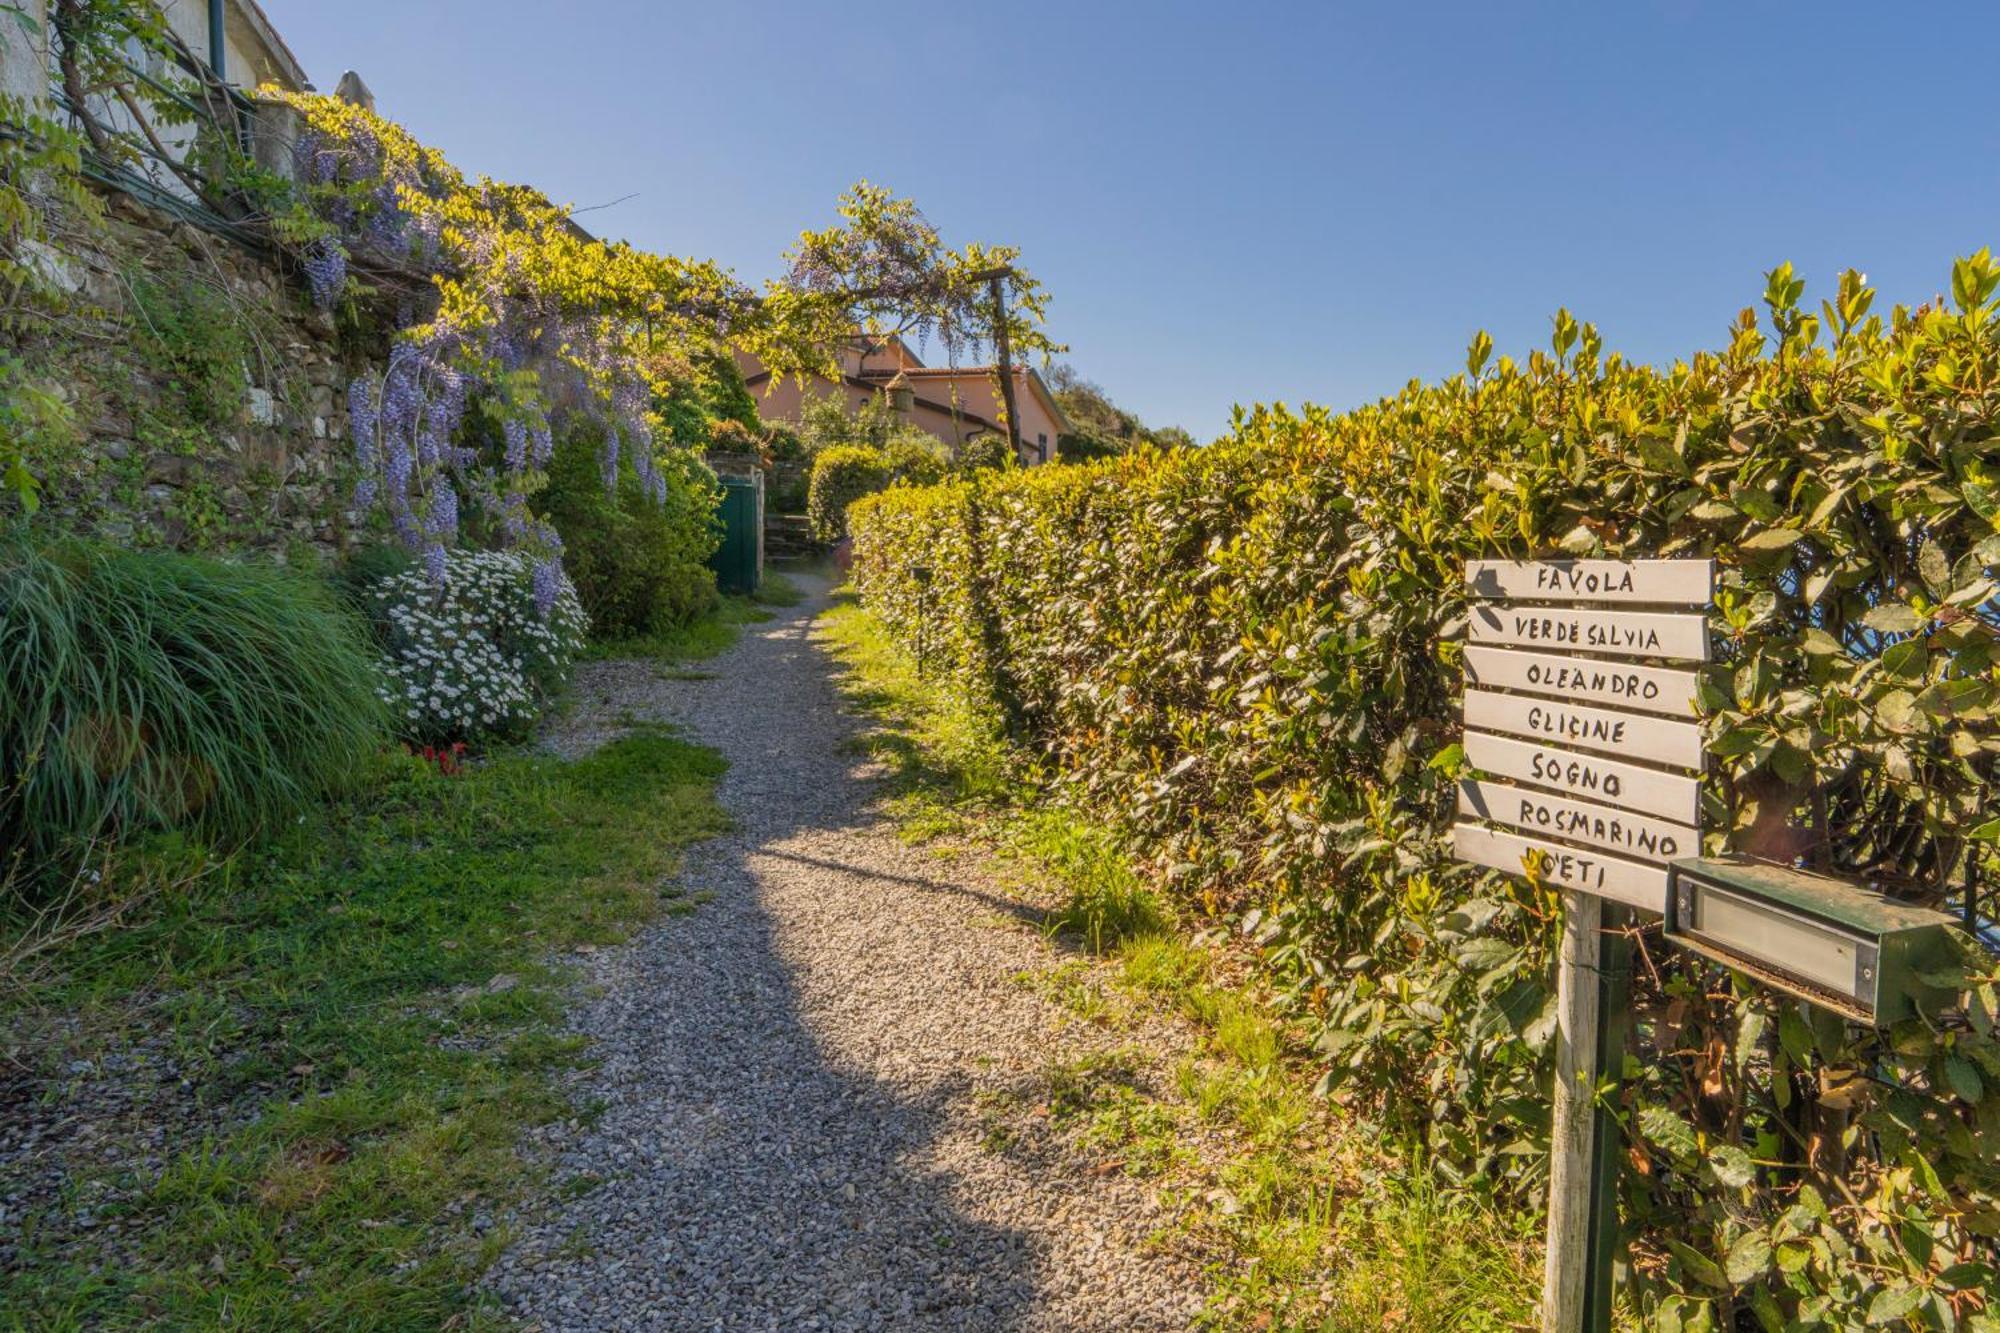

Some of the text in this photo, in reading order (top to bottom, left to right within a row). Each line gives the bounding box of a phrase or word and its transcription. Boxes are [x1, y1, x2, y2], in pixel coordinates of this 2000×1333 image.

[1537, 568, 1634, 592] FAVOLA
[1515, 616, 1661, 650] VERDE SALVIA
[1527, 664, 1659, 699] OLEANDRO
[1528, 707, 1625, 743] GLICINE
[1531, 752, 1620, 797] SOGNO
[1520, 799, 1678, 856] ROSMARINO
